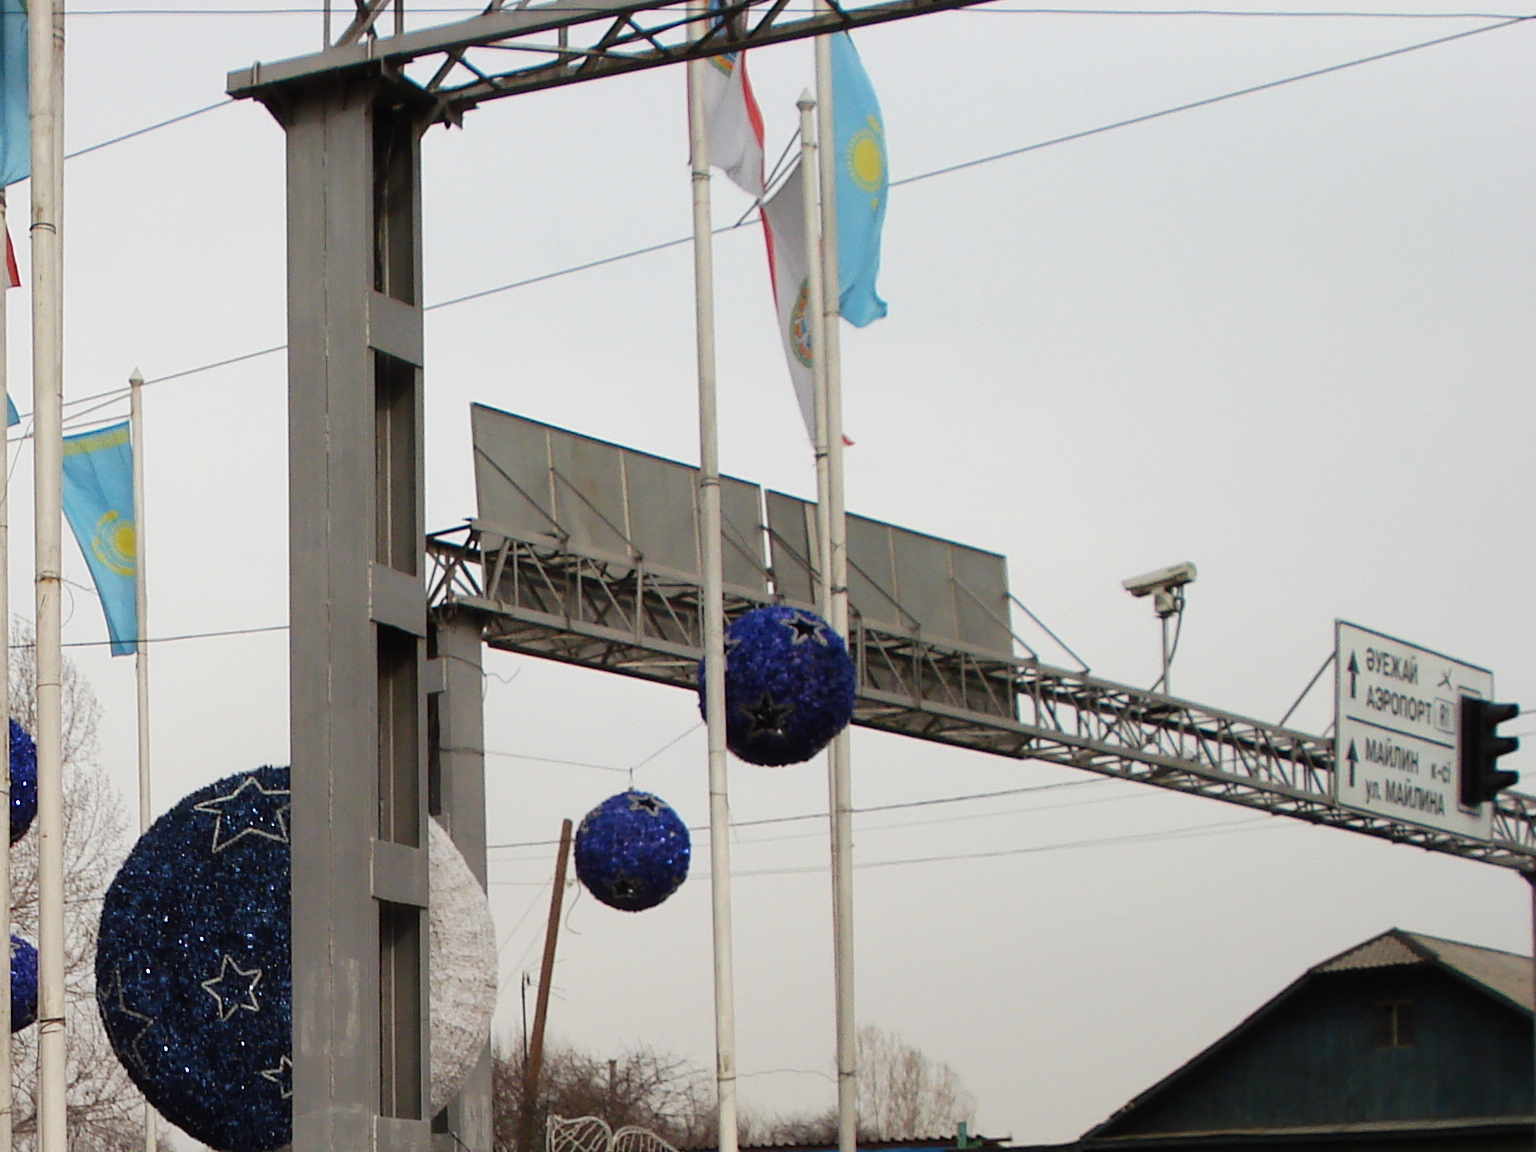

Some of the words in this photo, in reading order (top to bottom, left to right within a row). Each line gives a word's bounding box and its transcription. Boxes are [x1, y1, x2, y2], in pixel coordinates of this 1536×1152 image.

[1366, 685, 1432, 725] АЭРОПОРТ
[1365, 737, 1419, 775] МАЙЛИН
[1385, 778, 1446, 816] МАЙЛИНА
